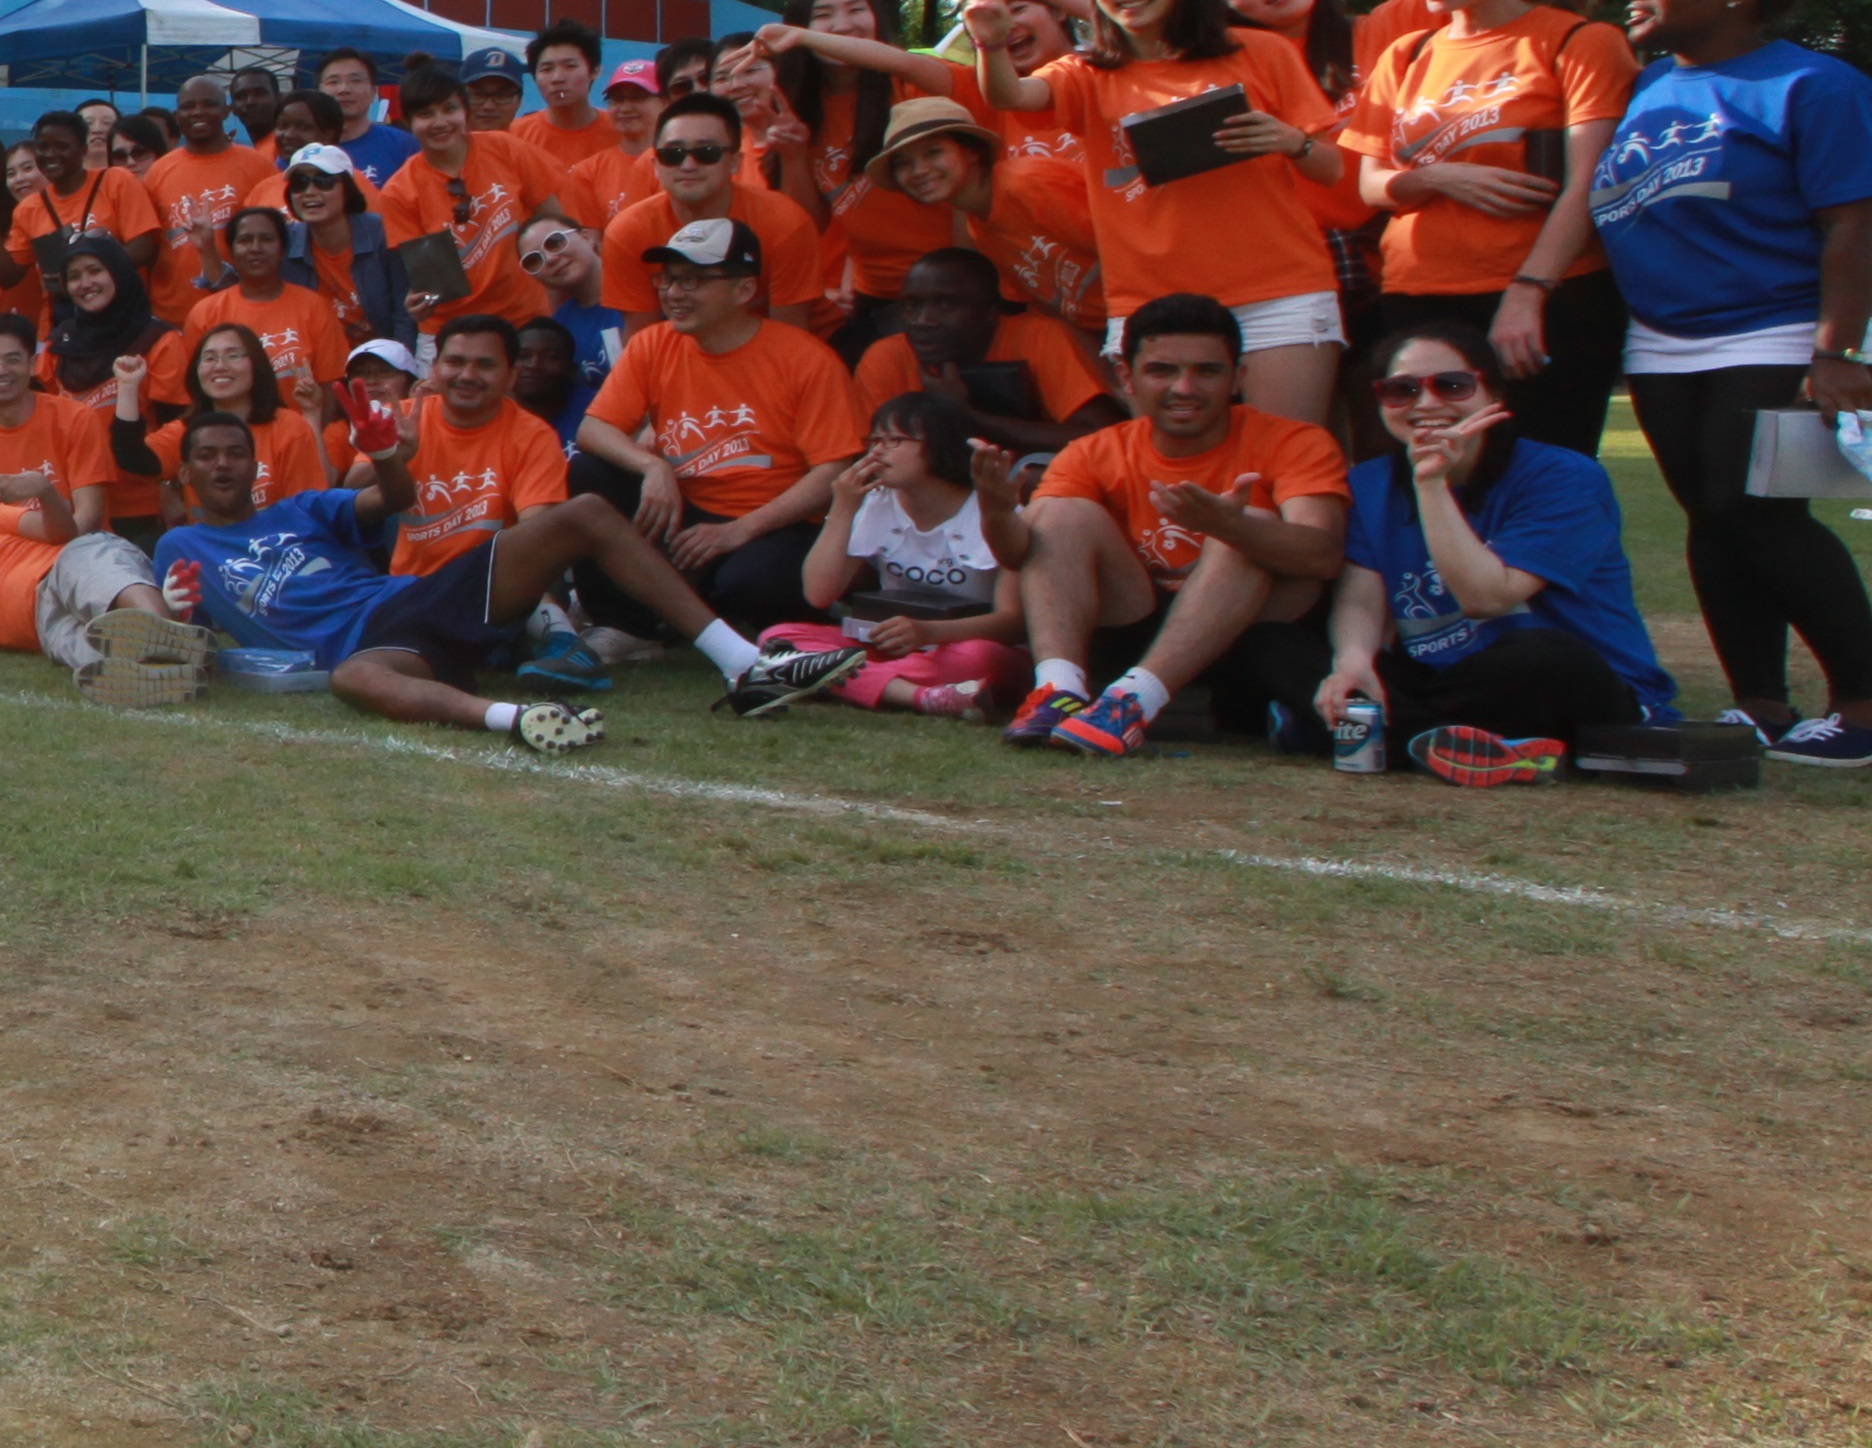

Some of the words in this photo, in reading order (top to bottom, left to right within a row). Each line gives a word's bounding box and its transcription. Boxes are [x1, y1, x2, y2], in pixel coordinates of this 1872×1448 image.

[1434, 127, 1458, 153] DAY
[1460, 106, 1501, 136] 2013
[1637, 177, 1663, 205] DAY
[1662, 156, 1706, 185] 2013
[491, 208, 511, 231] 2013
[273, 352, 295, 371] 2013
[698, 448, 720, 470] DAY
[723, 438, 750, 458] 2013
[443, 515, 463, 533] DAY
[465, 500, 488, 521] 2013
[281, 547, 306, 577] 2013
[1408, 627, 1469, 657] SPORTS
[1337, 720, 1368, 740] ite
